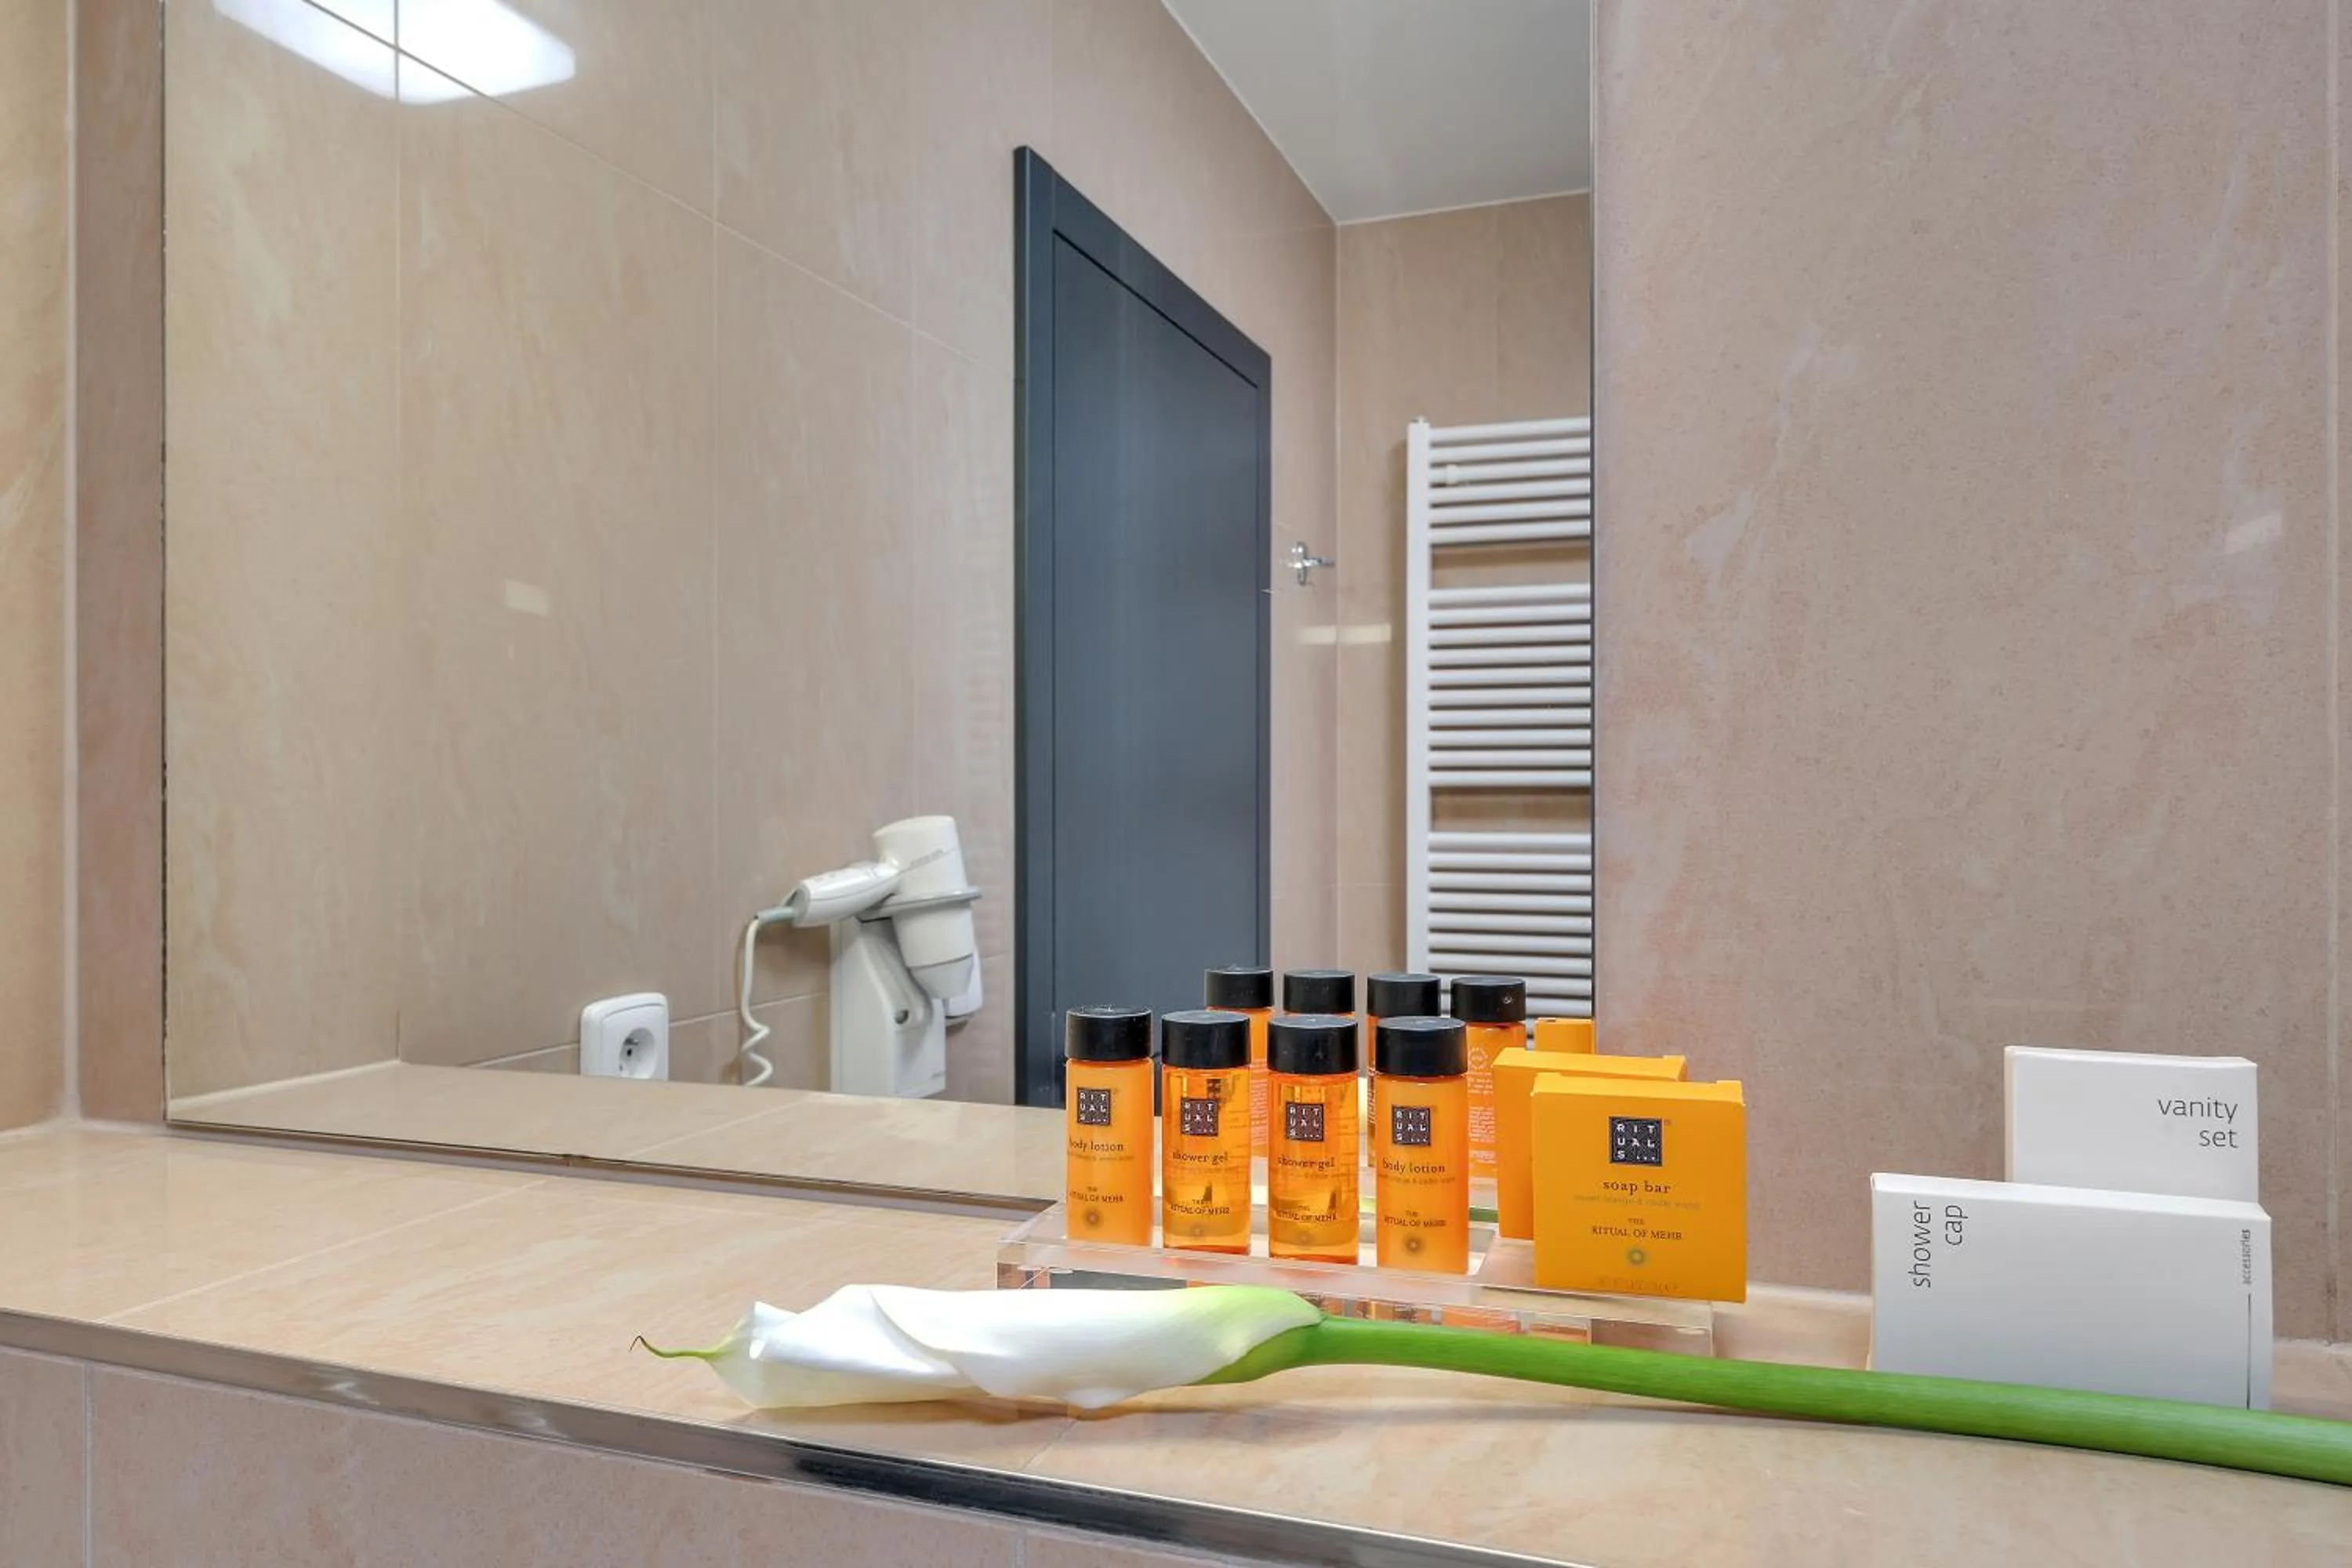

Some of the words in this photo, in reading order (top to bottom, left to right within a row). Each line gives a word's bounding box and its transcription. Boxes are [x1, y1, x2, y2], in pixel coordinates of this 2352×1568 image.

[2158, 1097, 2238, 1124] vanity
[1091, 1141, 1124, 1152] lotion
[2198, 1129, 2239, 1148] set
[1172, 1151, 1208, 1163] shower
[1211, 1151, 1229, 1165] gel
[1278, 1154, 1316, 1167] shower
[1318, 1156, 1335, 1171] gel
[1382, 1156, 1406, 1174] body
[1410, 1160, 1446, 1174] lotion
[1602, 1181, 1638, 1196] soap
[1644, 1180, 1671, 1194] bar
[1592, 1225, 1628, 1238] RITUAL
[1633, 1229, 1648, 1238] OF
[1945, 1205, 1969, 1245] cap
[1907, 1200, 1931, 1288] shower
